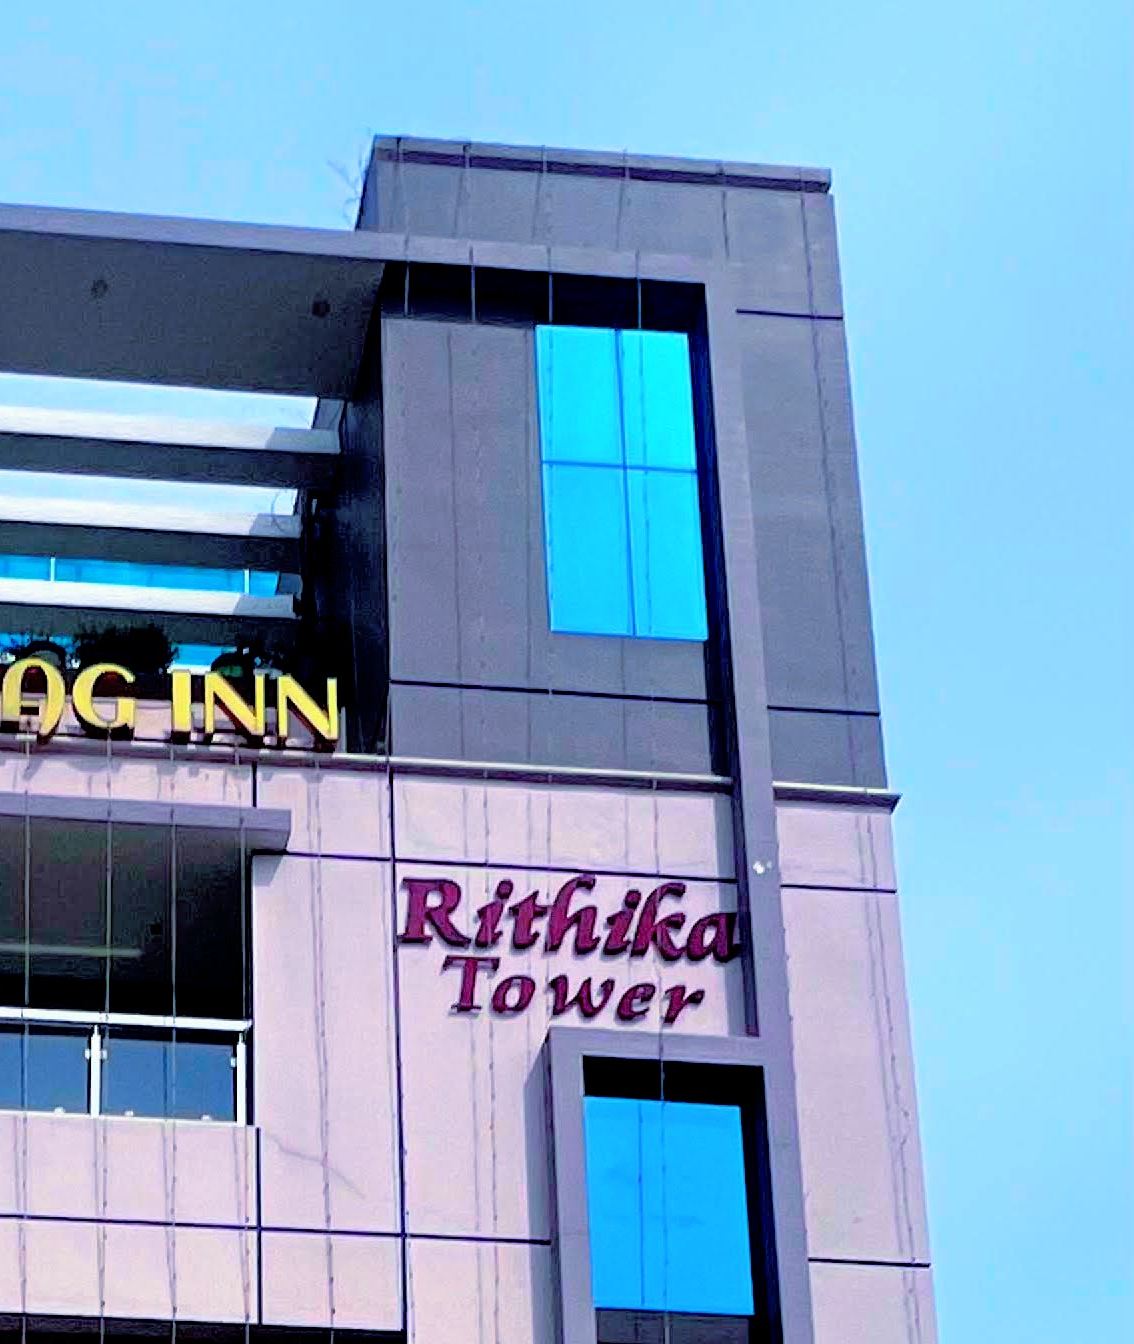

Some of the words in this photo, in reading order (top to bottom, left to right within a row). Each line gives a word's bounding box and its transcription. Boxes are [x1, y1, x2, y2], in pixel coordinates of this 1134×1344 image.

[171, 669, 339, 741] INN
[397, 874, 742, 963] Rithika
[442, 955, 706, 1025] Tower
